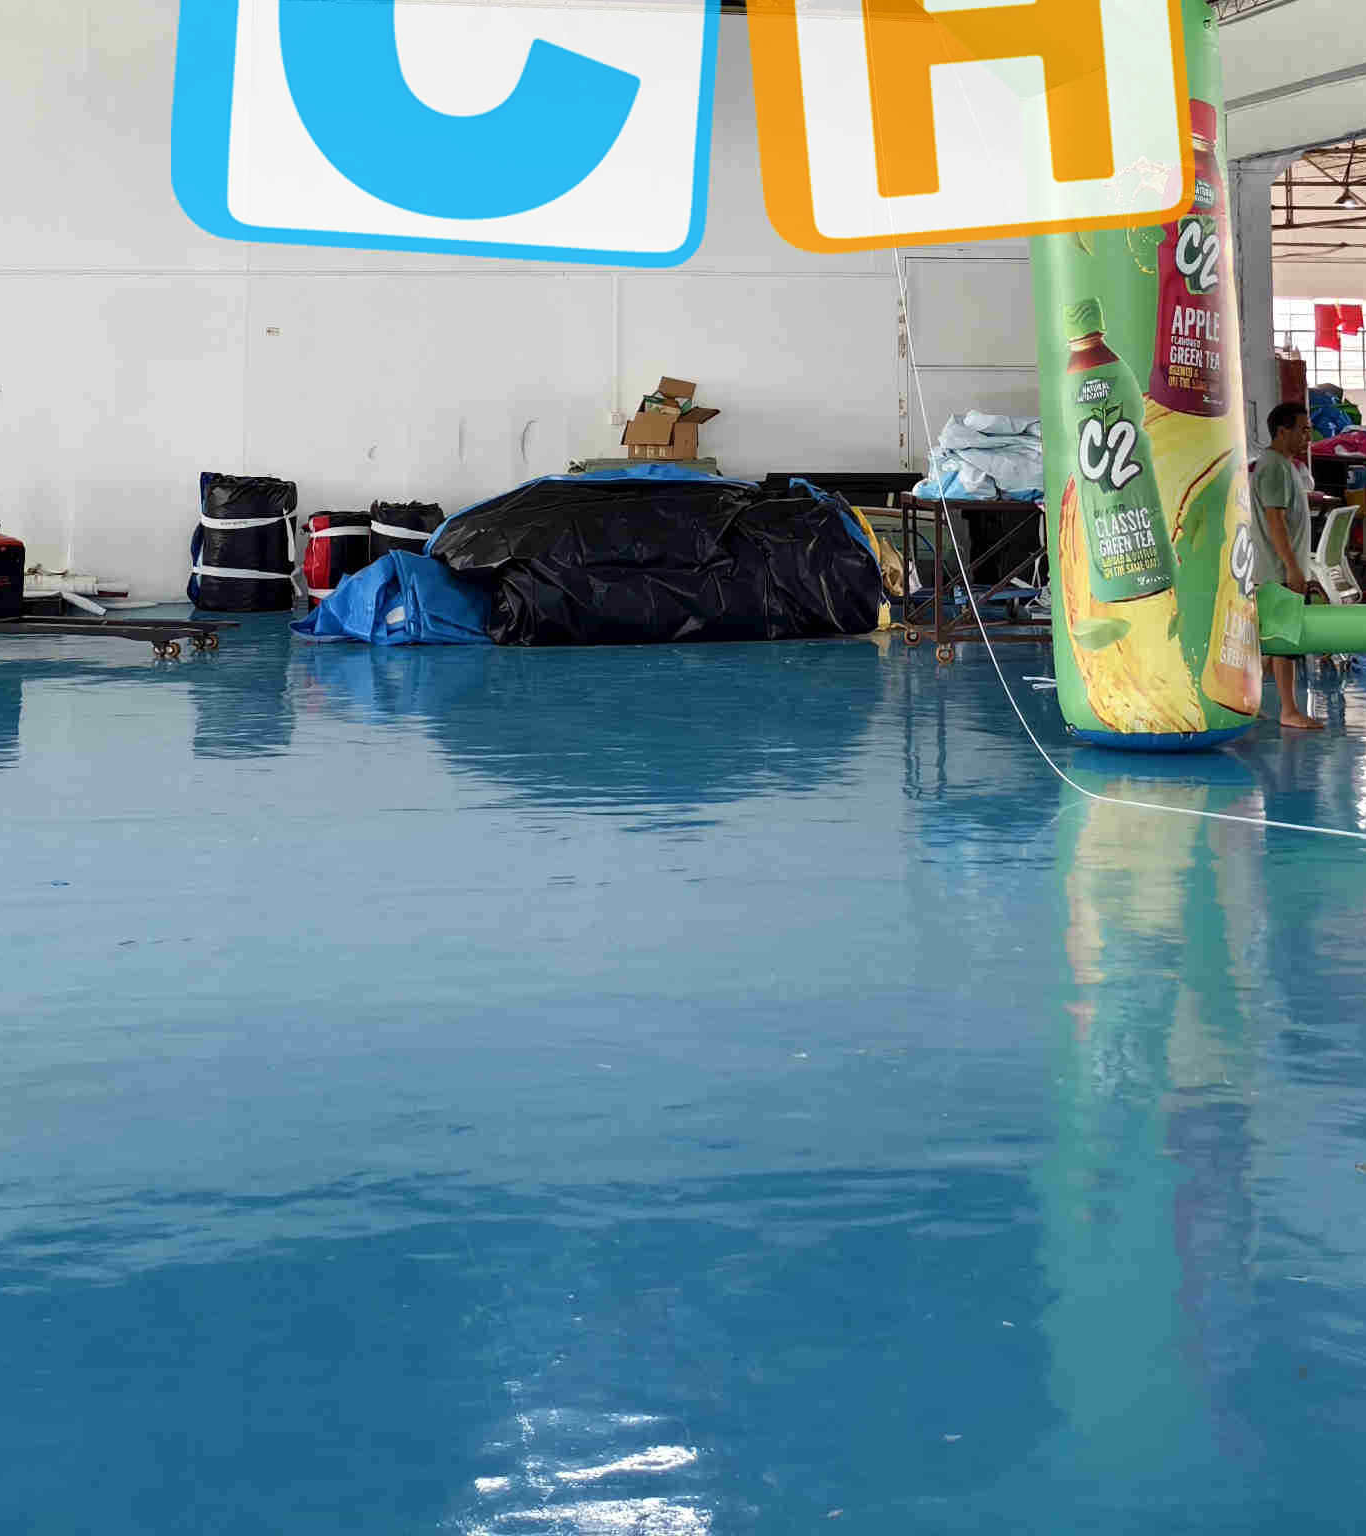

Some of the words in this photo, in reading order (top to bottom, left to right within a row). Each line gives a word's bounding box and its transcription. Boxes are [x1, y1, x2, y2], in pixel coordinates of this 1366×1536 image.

[1176, 221, 1220, 289] C2
[1171, 305, 1220, 342] APPLE
[1169, 345, 1203, 369] GREEN
[1080, 419, 1140, 487] C2
[1095, 507, 1151, 538] CLASSIC
[1099, 534, 1133, 557] GREEN
[1133, 529, 1156, 548] TEA
